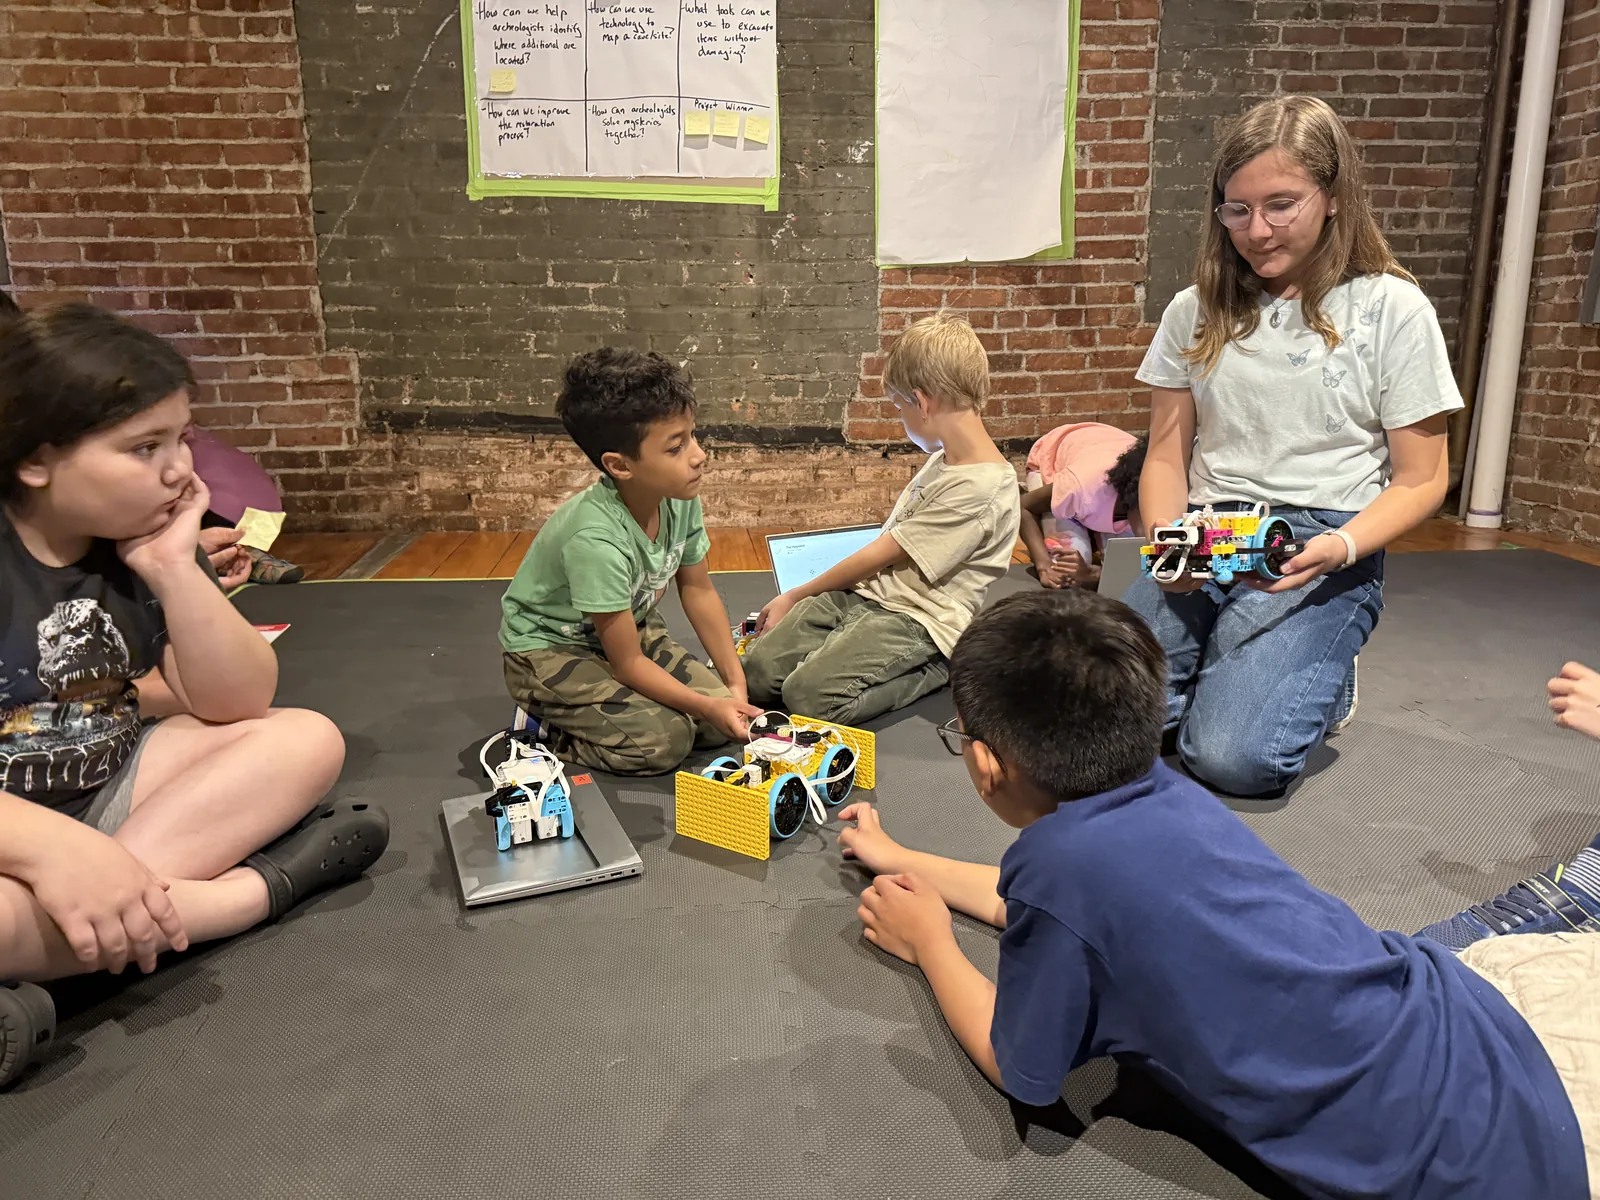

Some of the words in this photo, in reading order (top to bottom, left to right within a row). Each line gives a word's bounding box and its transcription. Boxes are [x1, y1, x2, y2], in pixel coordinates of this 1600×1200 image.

[502, 8, 520, 17] can
[545, 4, 567, 21] help
[625, 6, 637, 14] we
[638, 6, 655, 14] use
[716, 3, 736, 16] tools
[741, 7, 756, 16] can
[550, 23, 582, 38] identify
[599, 17, 645, 34] technology
[646, 17, 655, 27] to
[721, 18, 731, 30] to
[623, 33, 631, 41] a
[696, 33, 718, 43] items
[521, 38, 559, 50] additional
[496, 52, 530, 65] located?
[698, 45, 745, 63] damaging?
[538, 106, 570, 118] improve
[632, 103, 676, 119] archeologists
[498, 117, 513, 131] the
[499, 127, 529, 146] process?
